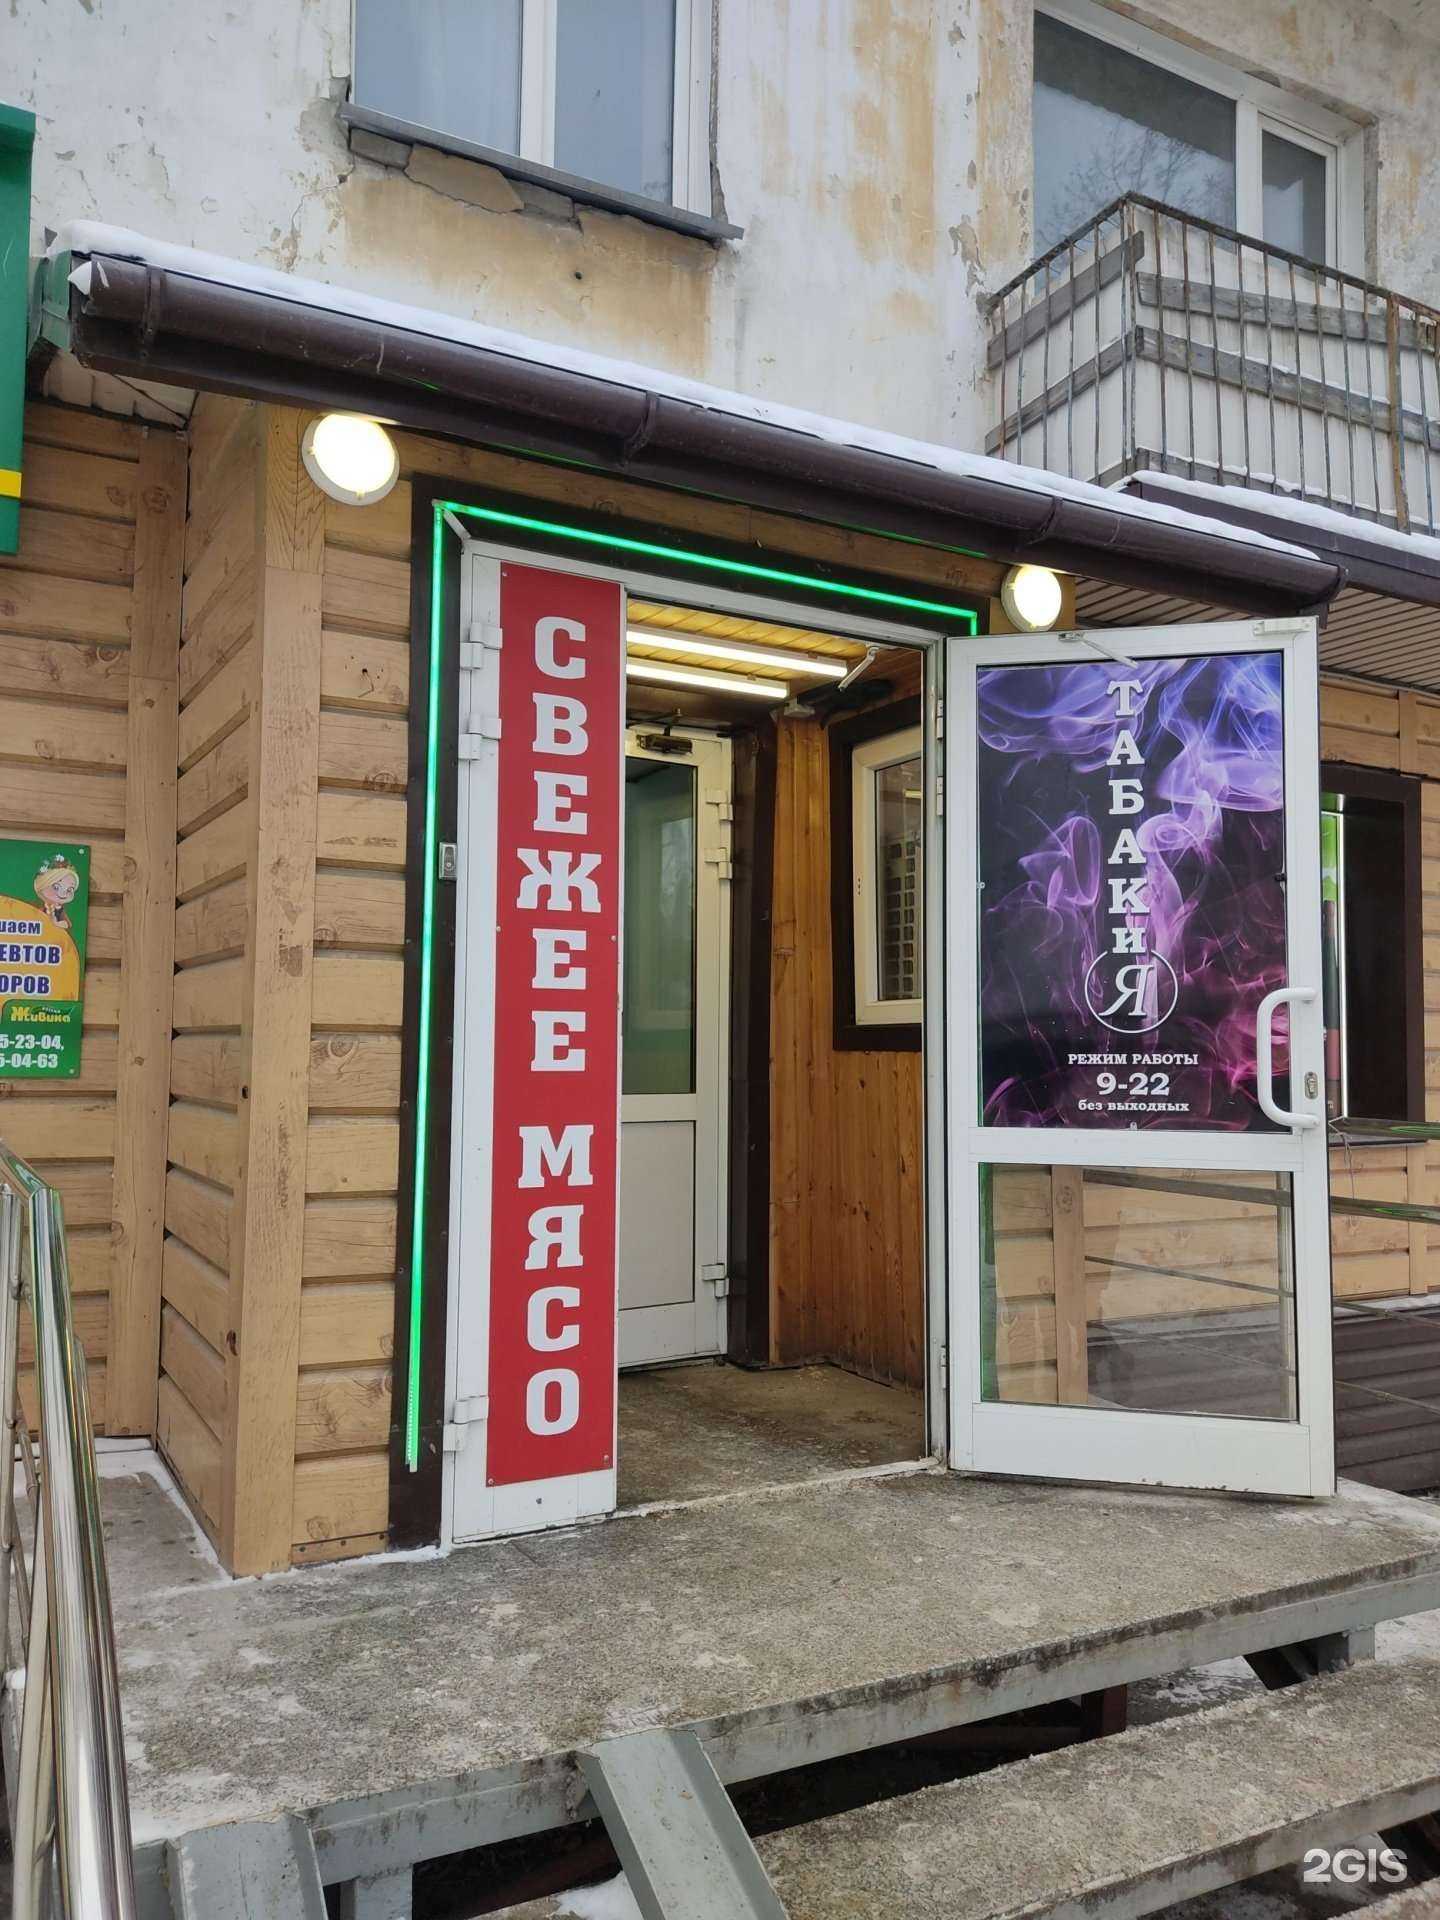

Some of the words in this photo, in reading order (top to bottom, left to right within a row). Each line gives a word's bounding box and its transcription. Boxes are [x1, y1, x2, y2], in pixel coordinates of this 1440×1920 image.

[516, 616, 602, 1072] СВЕЖЕЕ
[1067, 1053, 1127, 1065] РЕЖИМ
[1132, 1053, 1199, 1065] РАБОТЫ
[1096, 1072, 1170, 1096] 9-22
[1078, 1099, 1103, 1111] без
[1107, 1101, 1190, 1112] выходных
[517, 1124, 594, 1436] МЯСО
